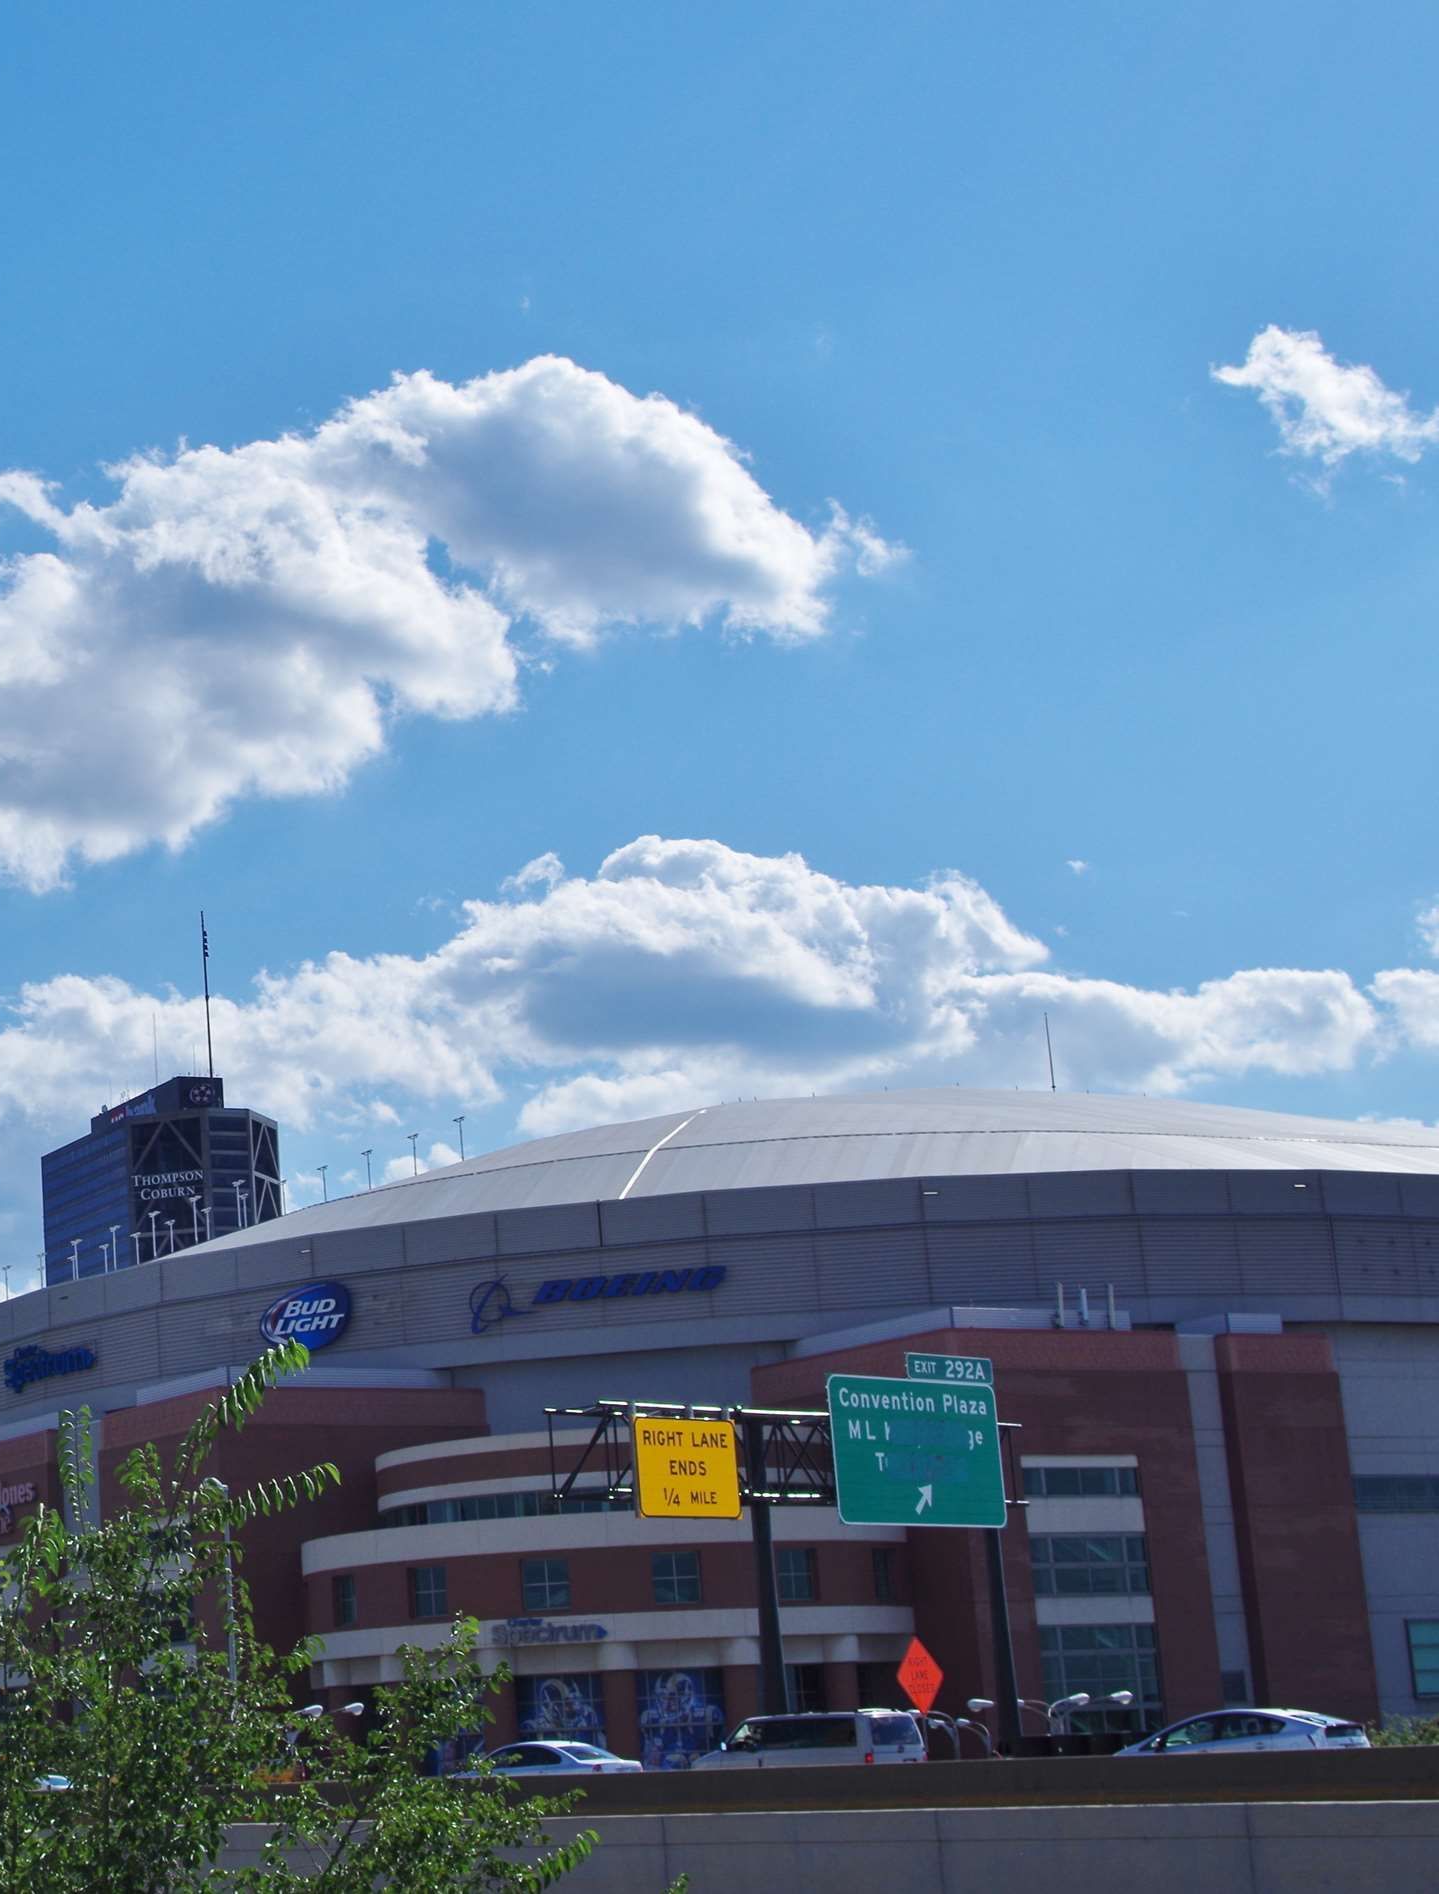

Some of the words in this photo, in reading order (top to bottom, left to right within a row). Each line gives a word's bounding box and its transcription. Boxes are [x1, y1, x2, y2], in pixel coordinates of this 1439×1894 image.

[131, 1169, 203, 1187] THOMPSON
[140, 1185, 196, 1200] COBURN
[532, 1265, 727, 1304] BOEING
[283, 1298, 336, 1318] BUD
[273, 1313, 344, 1336] LIGHT
[914, 1360, 936, 1374] EXIT
[945, 1360, 985, 1380] 292A
[839, 1387, 935, 1412] Convention
[942, 1394, 987, 1415] Plaza
[642, 1430, 683, 1447] RIGHT
[691, 1432, 728, 1449] LANE
[669, 1460, 707, 1476] ENDS
[690, 1491, 718, 1505] MILE
